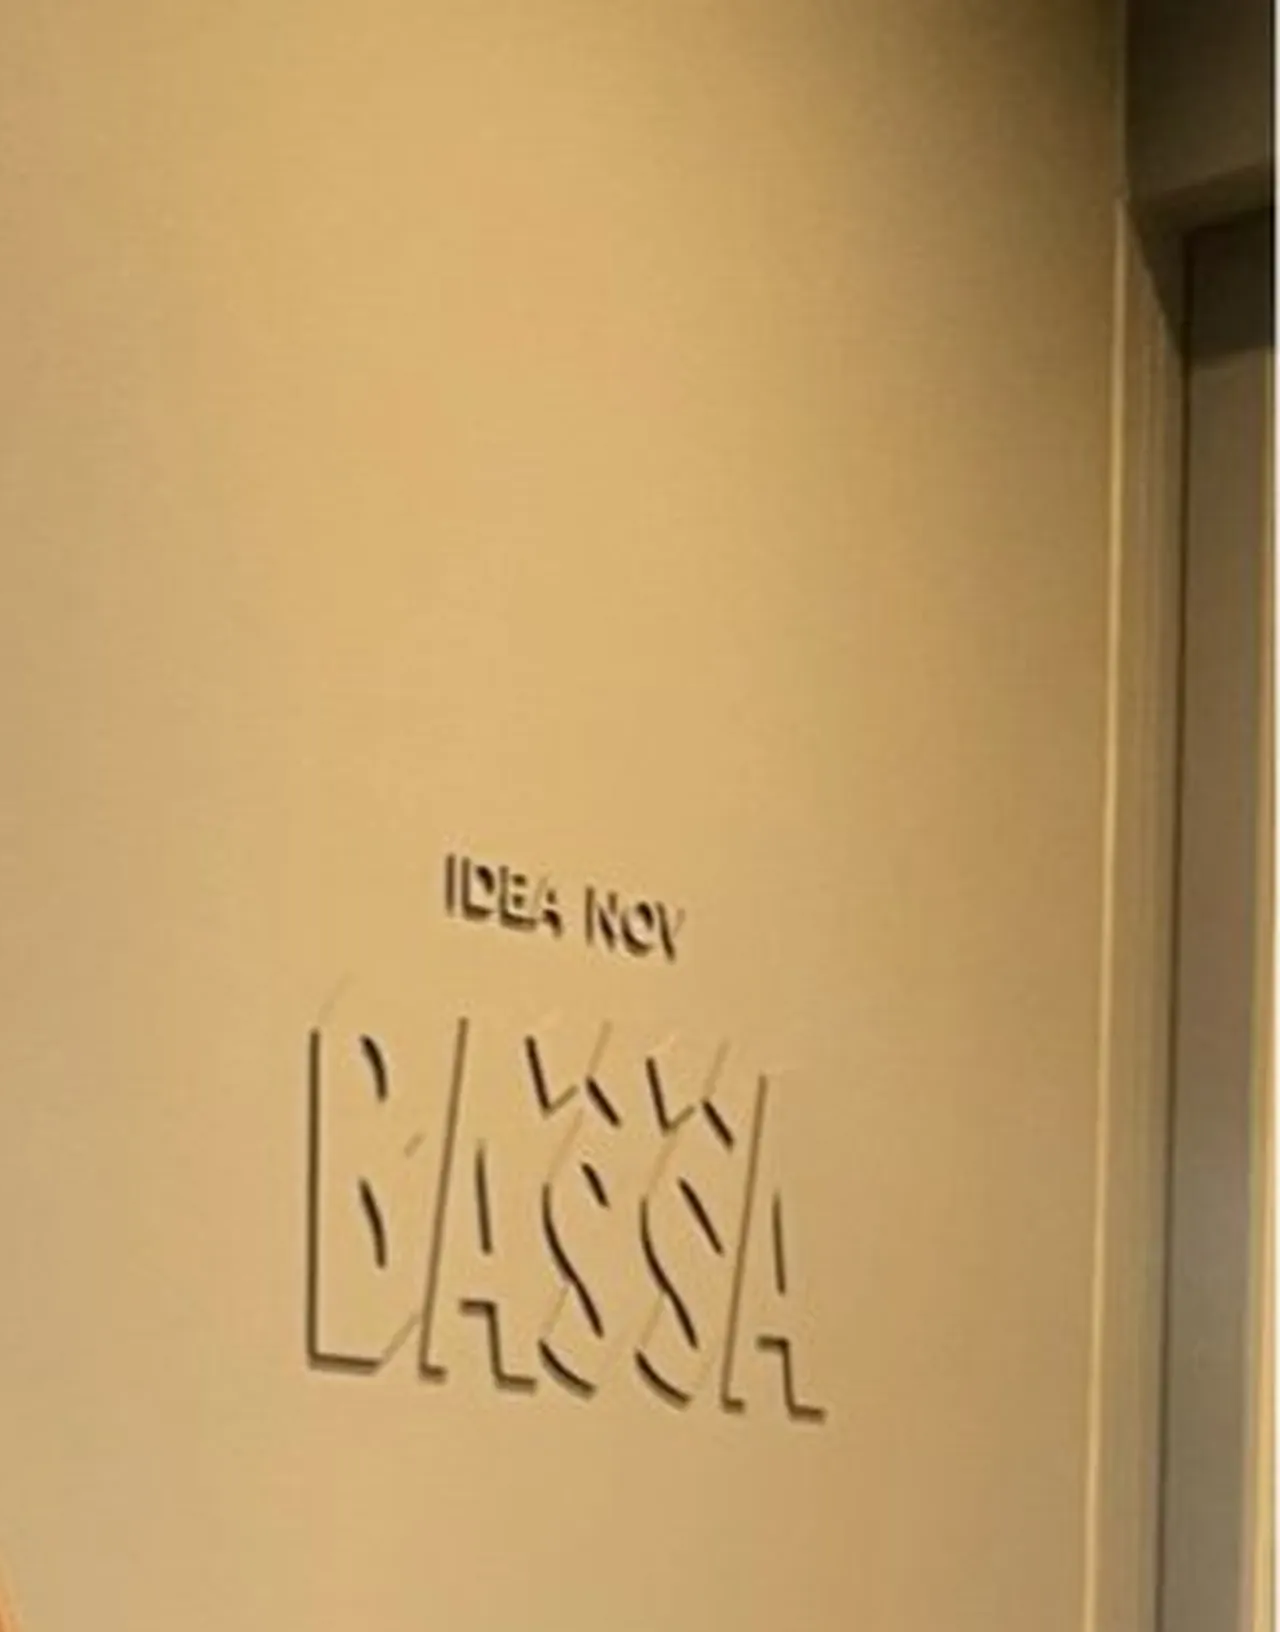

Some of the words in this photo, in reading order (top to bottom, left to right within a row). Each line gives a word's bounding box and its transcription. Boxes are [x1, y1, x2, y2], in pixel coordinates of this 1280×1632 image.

[444, 852, 565, 942] IDEA
[584, 884, 686, 965] NOV
[306, 985, 828, 1422] BASSA
